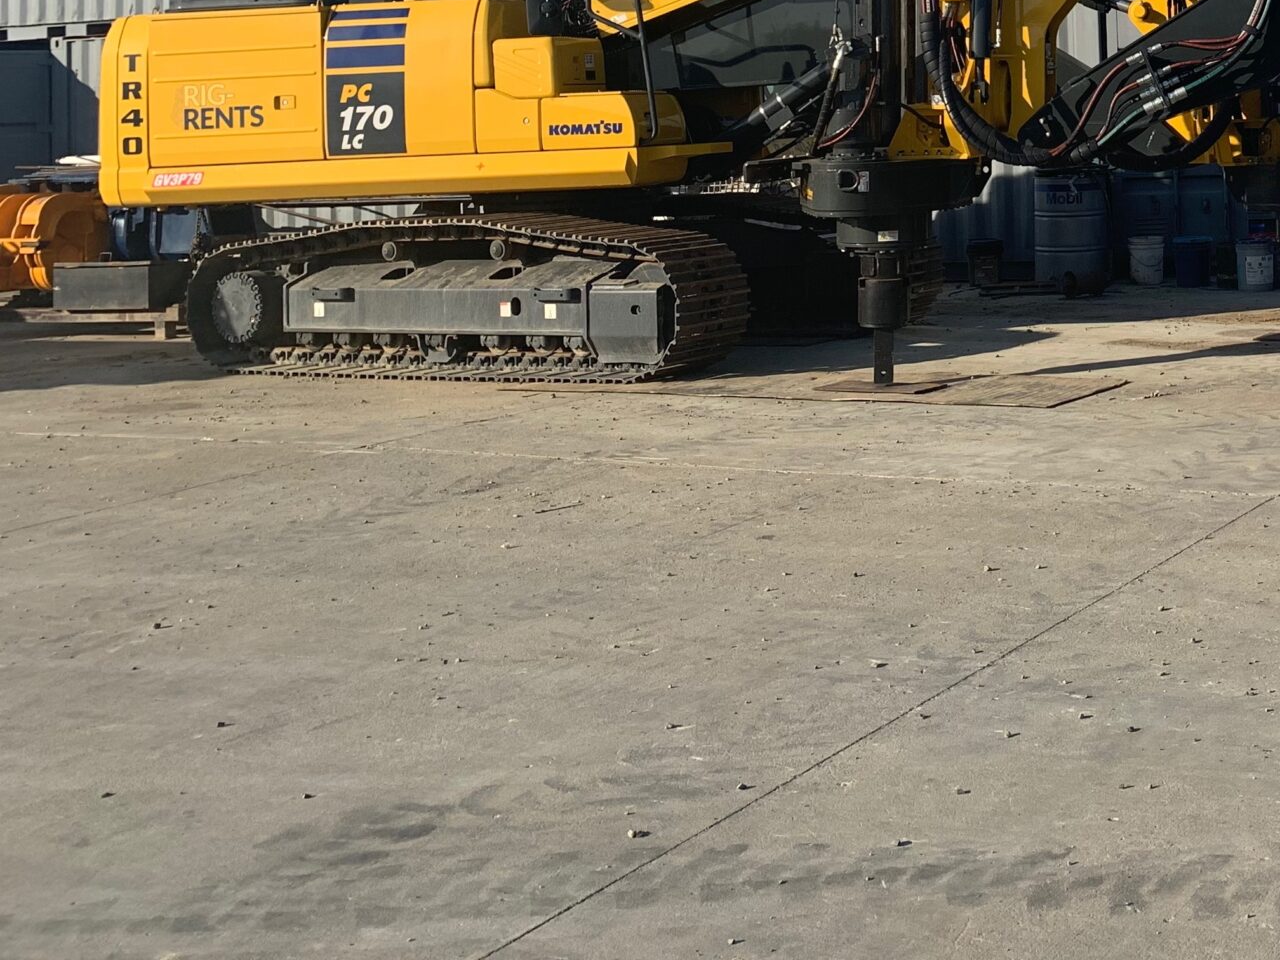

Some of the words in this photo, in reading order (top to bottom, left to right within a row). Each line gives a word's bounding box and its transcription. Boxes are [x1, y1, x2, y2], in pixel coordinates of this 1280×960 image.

[184, 84, 234, 107] RIG-
[340, 83, 373, 103] PC
[121, 54, 143, 155] TR40
[184, 105, 264, 130] RENTS
[340, 104, 394, 131] 170
[549, 120, 623, 136] KOMATSU
[341, 133, 365, 149] LC
[154, 172, 203, 187] GV3P79
[1046, 192, 1083, 204] Mobil
